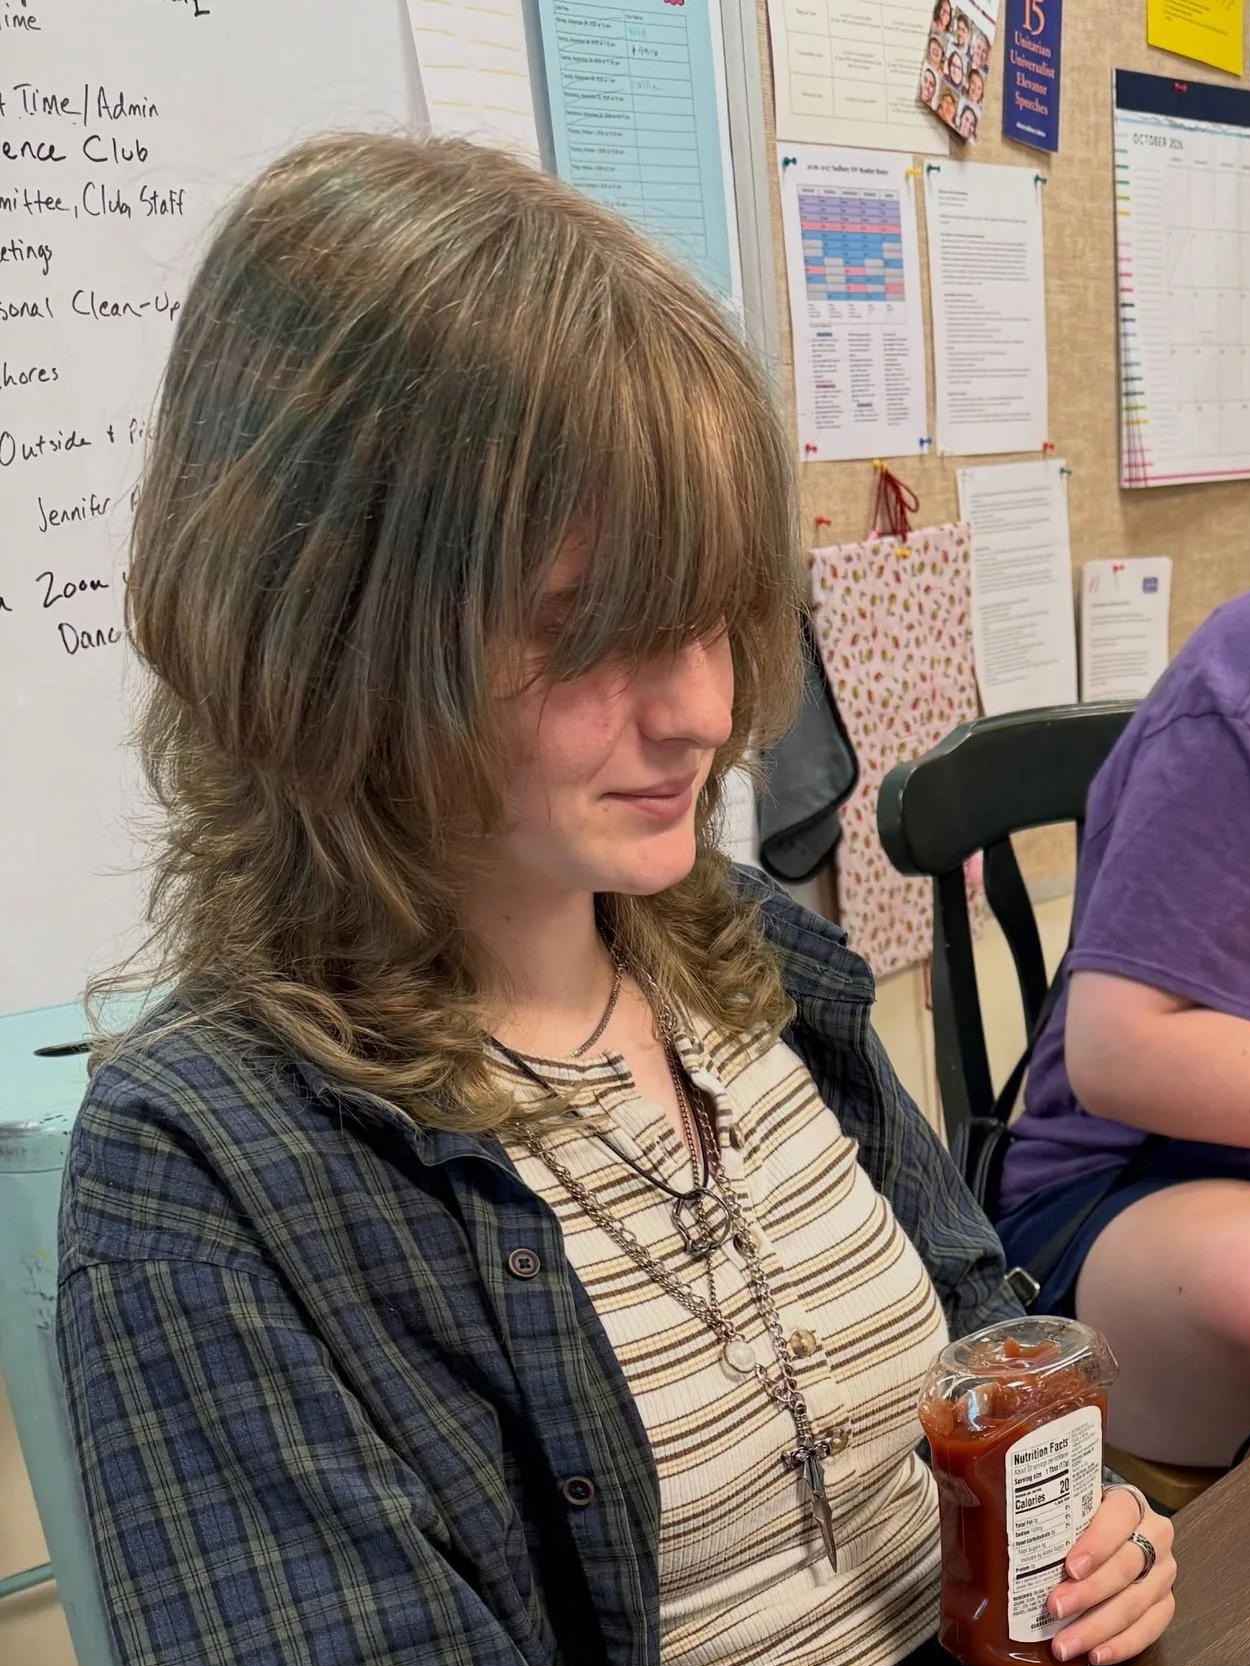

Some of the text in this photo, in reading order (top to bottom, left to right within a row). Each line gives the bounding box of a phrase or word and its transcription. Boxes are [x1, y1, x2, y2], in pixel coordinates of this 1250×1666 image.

[0, 14, 41, 31] ime
[1013, 30, 1051, 58] Unitarian
[1009, 49, 1055, 79] Universalist
[1016, 71, 1048, 96] Elevator
[1015, 90, 1049, 116] Speeches
[83, 134, 149, 163] Club
[1133, 133, 1167, 148] OCTOBER
[140, 185, 186, 216] Staff
[72, 290, 181, 321] Clean-Up
[0, 362, 58, 388] hores
[0, 431, 91, 466] Outside
[38, 494, 110, 532] Jennifer
[36, 572, 108, 608] Zoom
[58, 622, 121, 655] Danc
[1014, 1439, 1068, 1465] Nutrition Facts
[1015, 1474, 1032, 1485] Serving
[1033, 1472, 1042, 1480] size
[1015, 1494, 1046, 1510] Calories
[1060, 1478, 1069, 1494] 20
